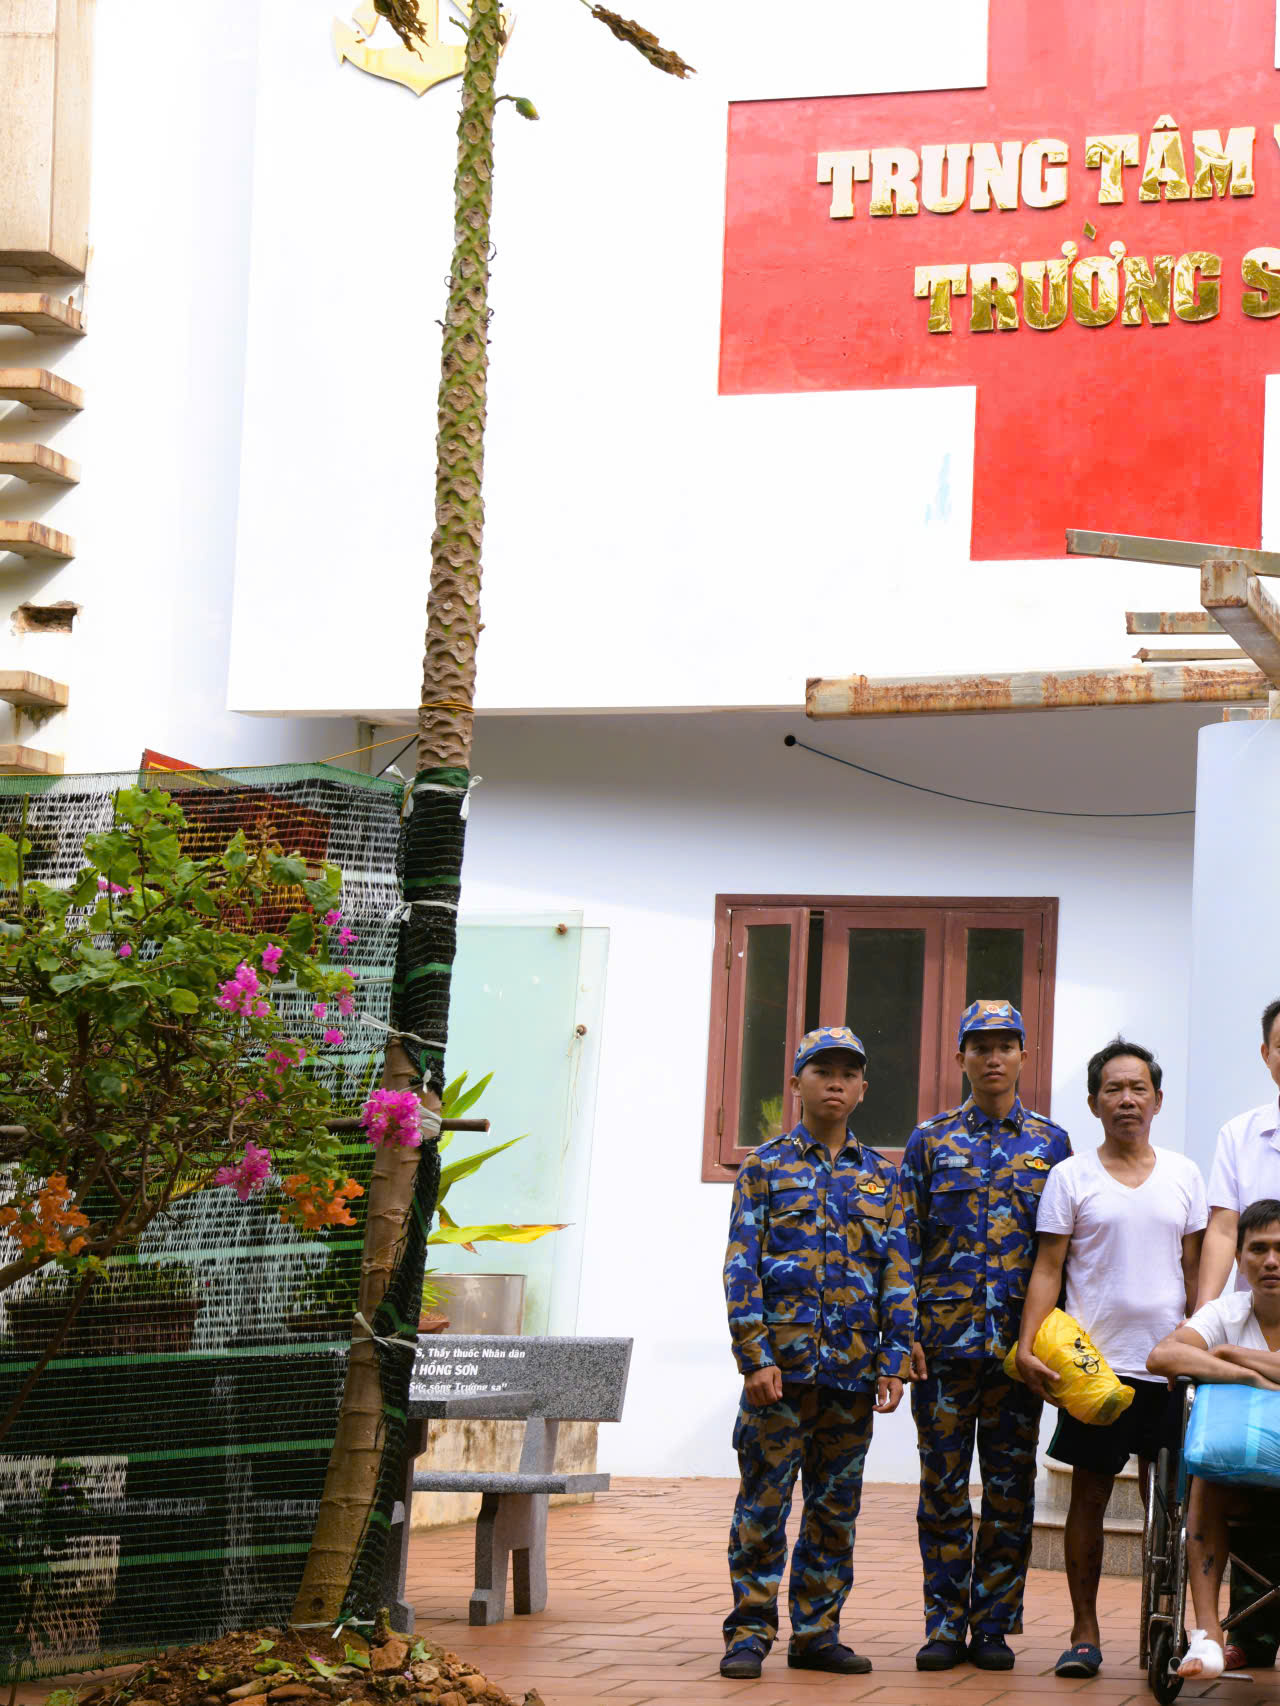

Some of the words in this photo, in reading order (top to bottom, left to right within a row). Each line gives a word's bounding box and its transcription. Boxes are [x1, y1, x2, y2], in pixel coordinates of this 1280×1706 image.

[816, 139, 1070, 219] TRUNG
[1085, 114, 1256, 204] TÂM
[914, 220, 1222, 334] TRƯỜNG
[455, 1363, 479, 1376] SƠN
[482, 1348, 506, 1359] Nhân
[508, 1348, 526, 1358] dân
